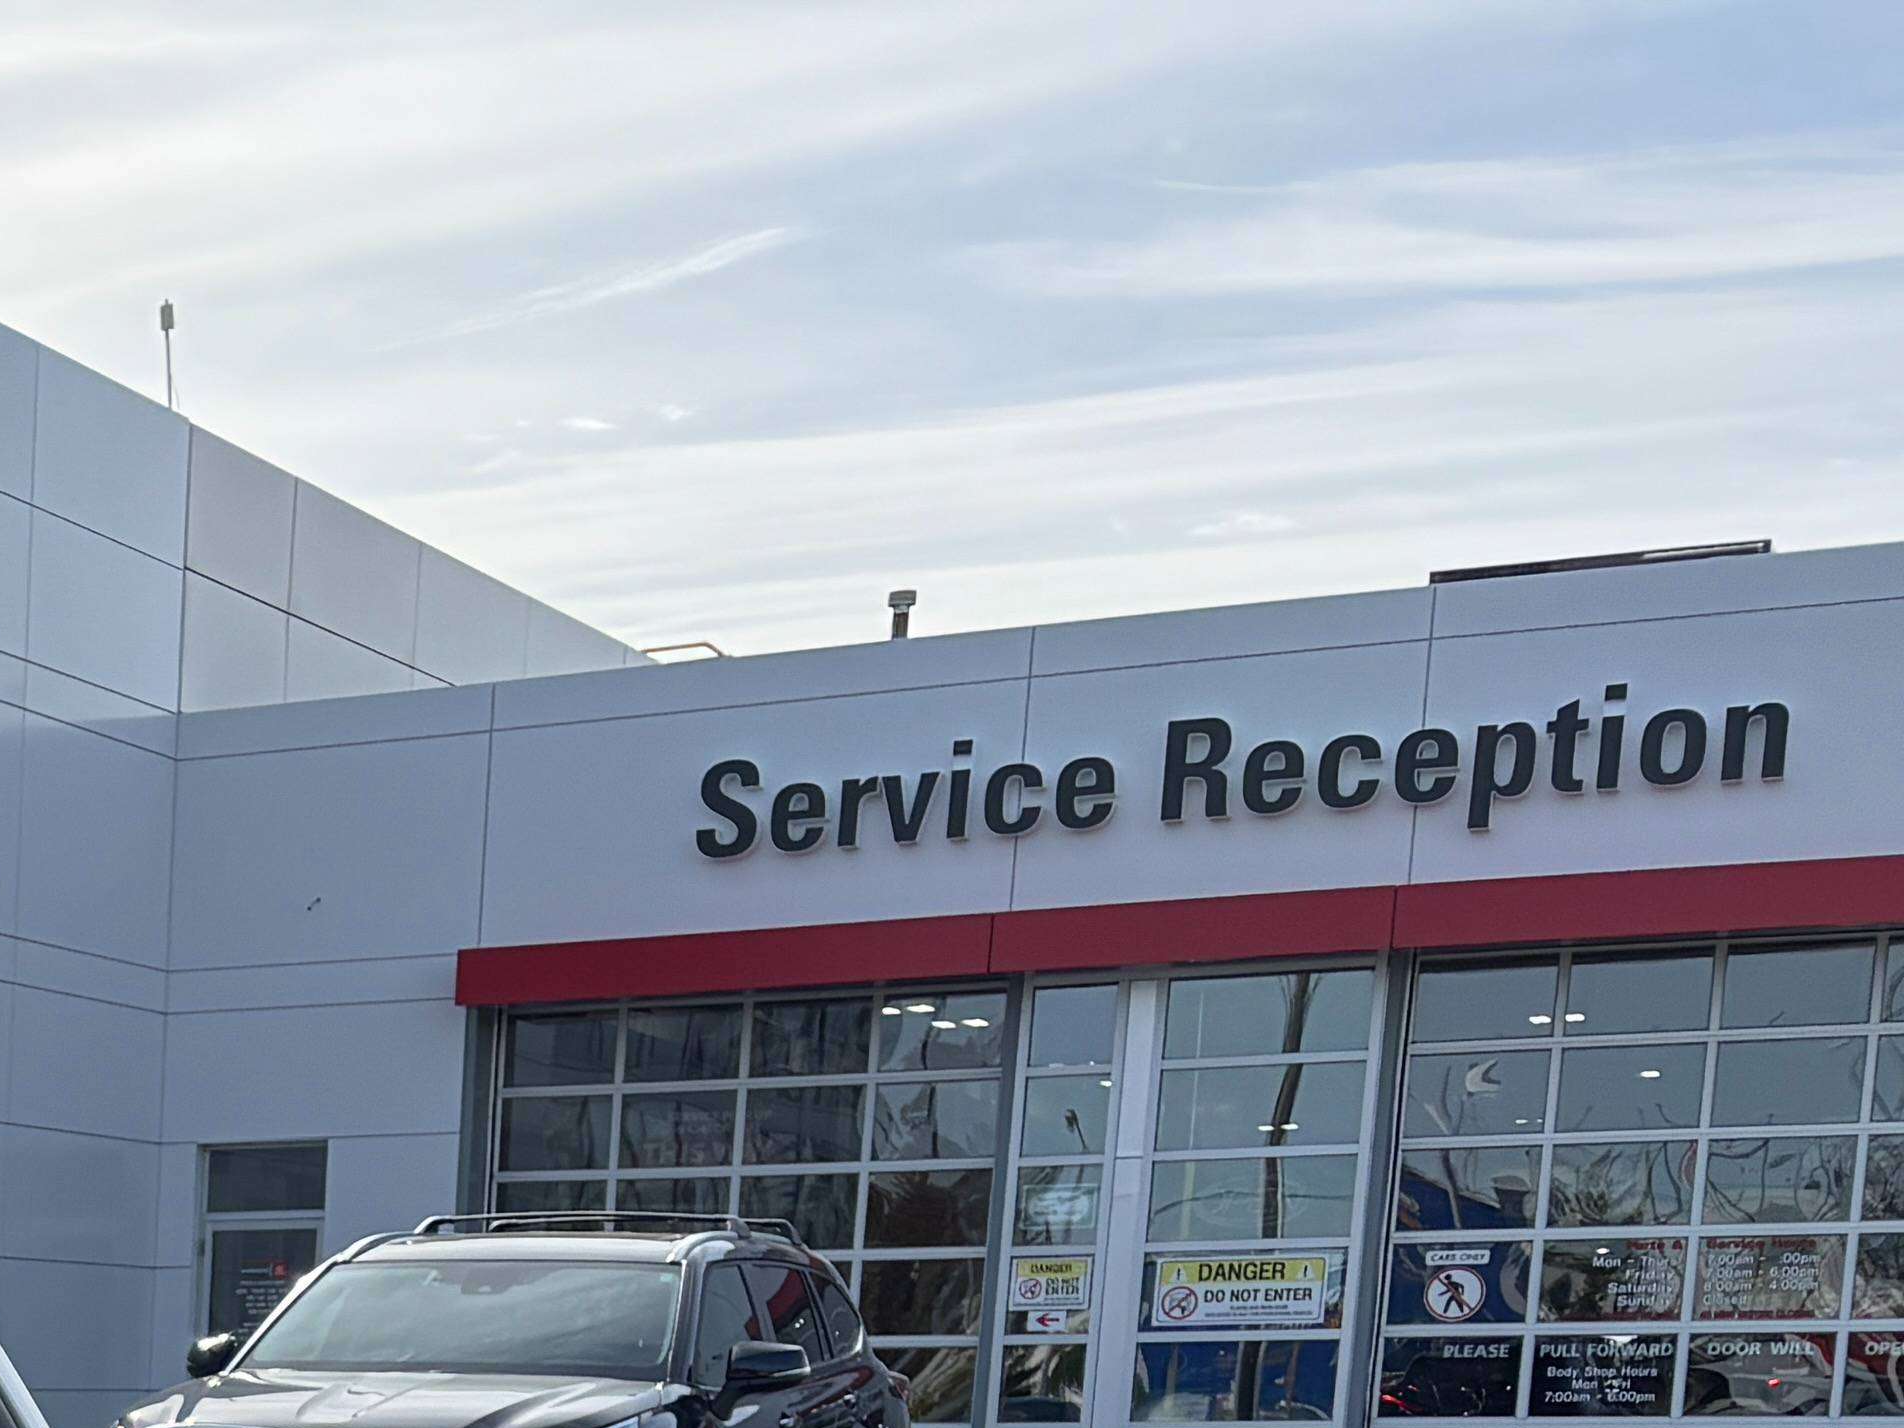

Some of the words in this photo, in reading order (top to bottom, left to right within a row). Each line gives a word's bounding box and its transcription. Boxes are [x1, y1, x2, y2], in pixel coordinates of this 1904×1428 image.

[696, 738, 1115, 860] Service
[1160, 682, 1789, 832] Reception
[1429, 1252, 1456, 1262] CARS
[1592, 1256, 1621, 1268] Mon
[1198, 1261, 1286, 1282] DANGER
[1203, 1289, 1225, 1303] DO
[1229, 1288, 1262, 1303] NOT
[1265, 1286, 1313, 1302] ENTER
[1442, 1344, 1510, 1359] PLEASE
[1539, 1343, 1581, 1358] PULL
[1586, 1342, 1674, 1358] FORWARD
[1707, 1342, 1761, 1356] DOOR
[1769, 1342, 1815, 1356] WILL
[1863, 1340, 1904, 1355] OPE
[1546, 1366, 1579, 1379] Body
[1584, 1366, 1617, 1379] Shop
[1621, 1366, 1658, 1378] Hours
[1571, 1379, 1599, 1390] Mon
[1544, 1391, 1591, 1403] 7:00am
